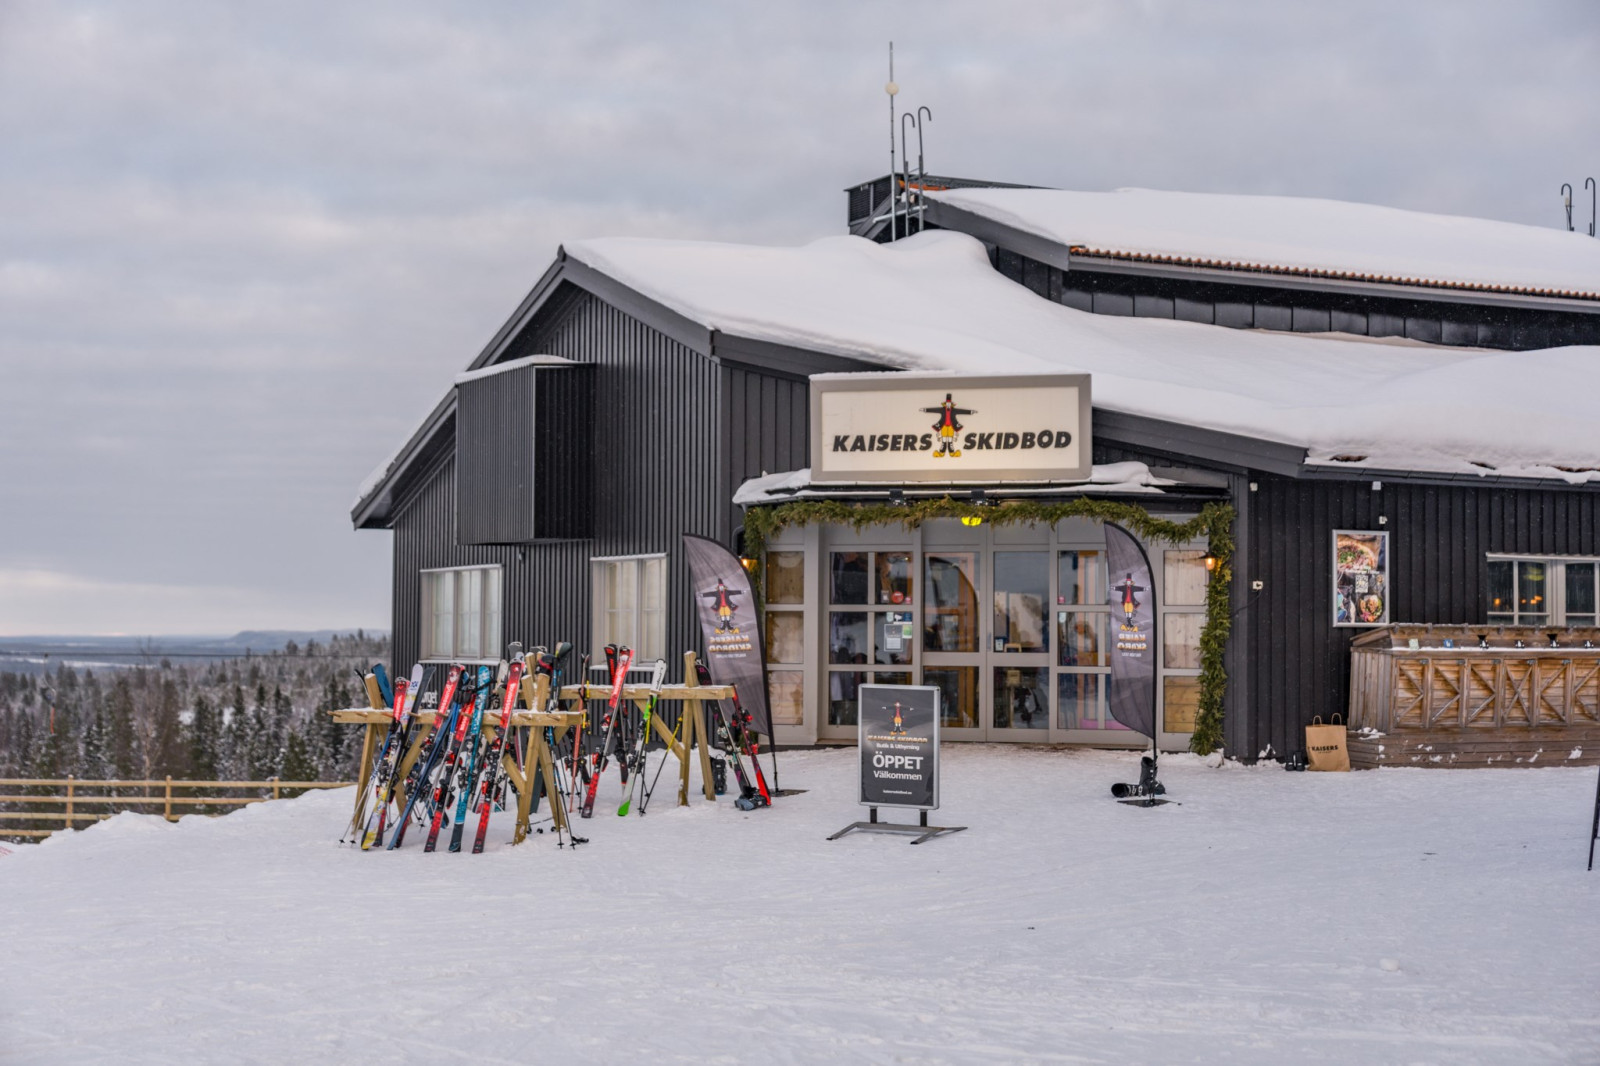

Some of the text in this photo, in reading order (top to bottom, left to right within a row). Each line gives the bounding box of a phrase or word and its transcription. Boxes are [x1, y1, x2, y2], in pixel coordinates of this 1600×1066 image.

[832, 429, 1072, 452] KAISERS SKIDBOD
[873, 751, 924, 770] ÖPPET
[873, 770, 922, 781] Välkommen
